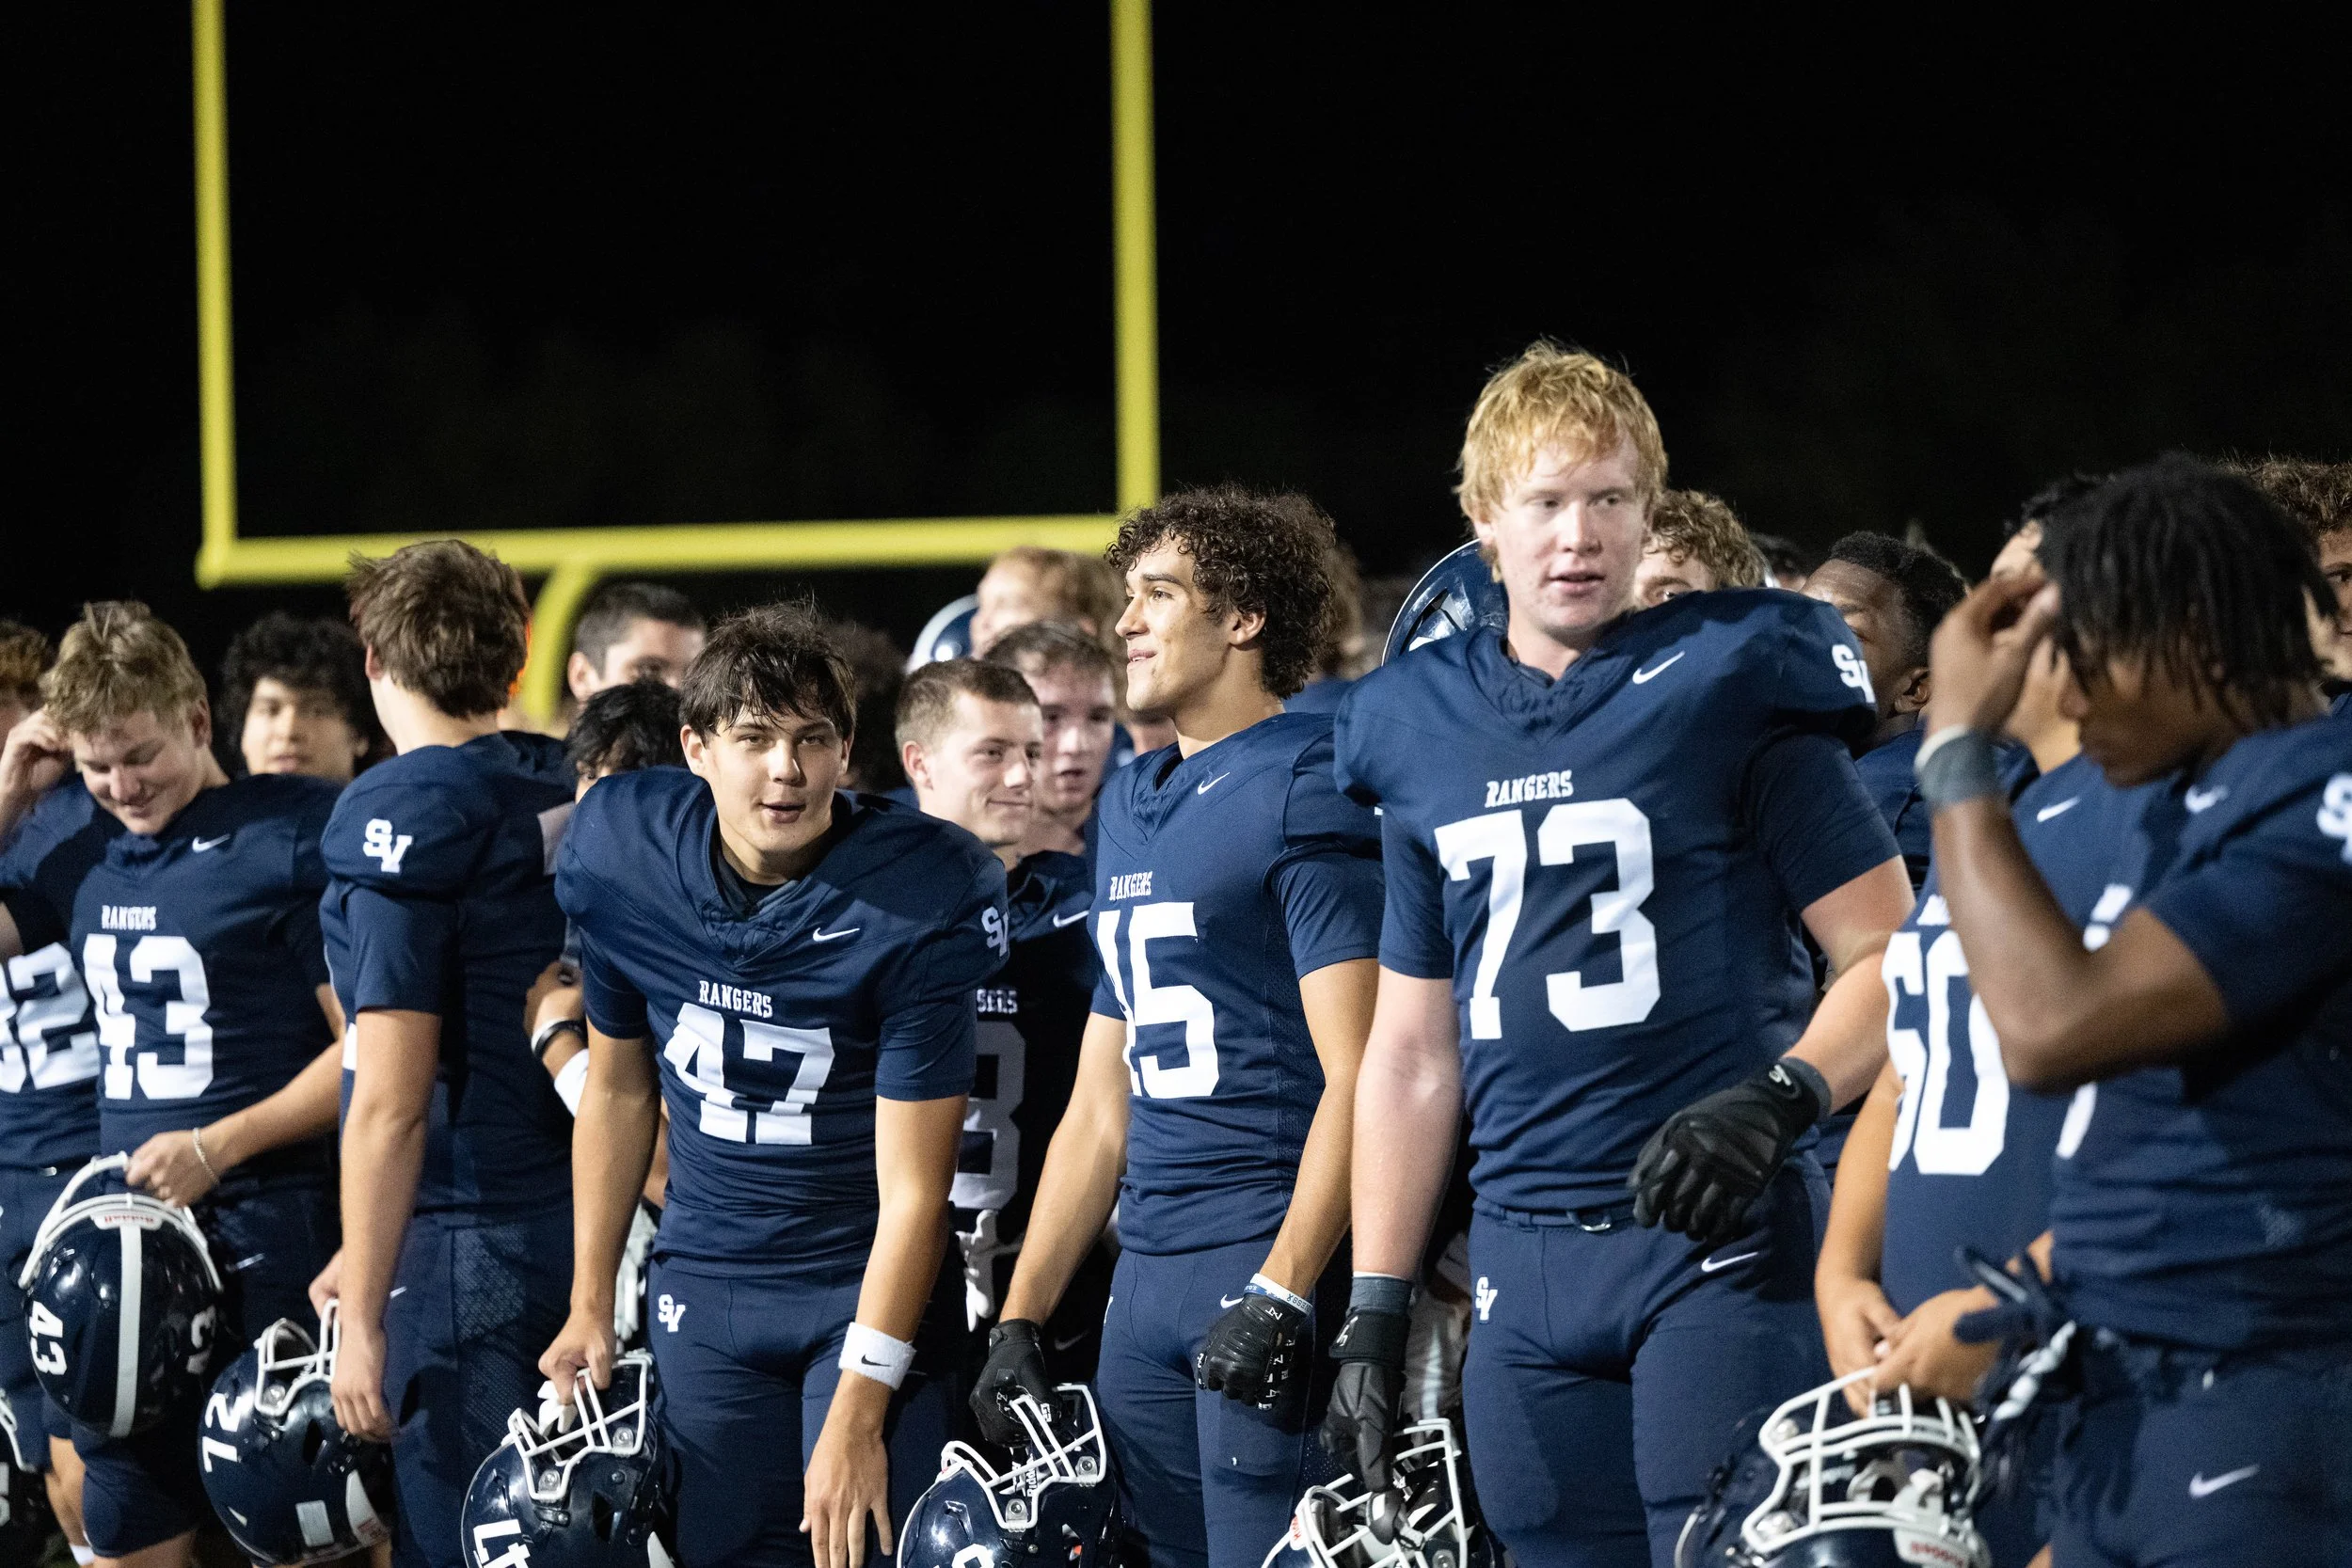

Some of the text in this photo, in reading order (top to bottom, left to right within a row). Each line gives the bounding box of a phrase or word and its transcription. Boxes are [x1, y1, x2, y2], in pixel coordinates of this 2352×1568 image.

[1486, 771, 1573, 808] RANGERS
[363, 818, 413, 874] SV
[2316, 772, 2352, 864] S
[1109, 871, 1152, 900] RANGERS
[102, 905, 157, 931] RANGERS
[1435, 798, 1661, 1039] 73
[83, 933, 215, 1101] 43
[699, 979, 772, 1020] RANGERS
[1096, 902, 1220, 1099] 15
[663, 1003, 835, 1146] 47
[658, 1293, 686, 1333] SV
[1475, 1276, 1499, 1321] SV
[29, 1300, 68, 1376] 43
